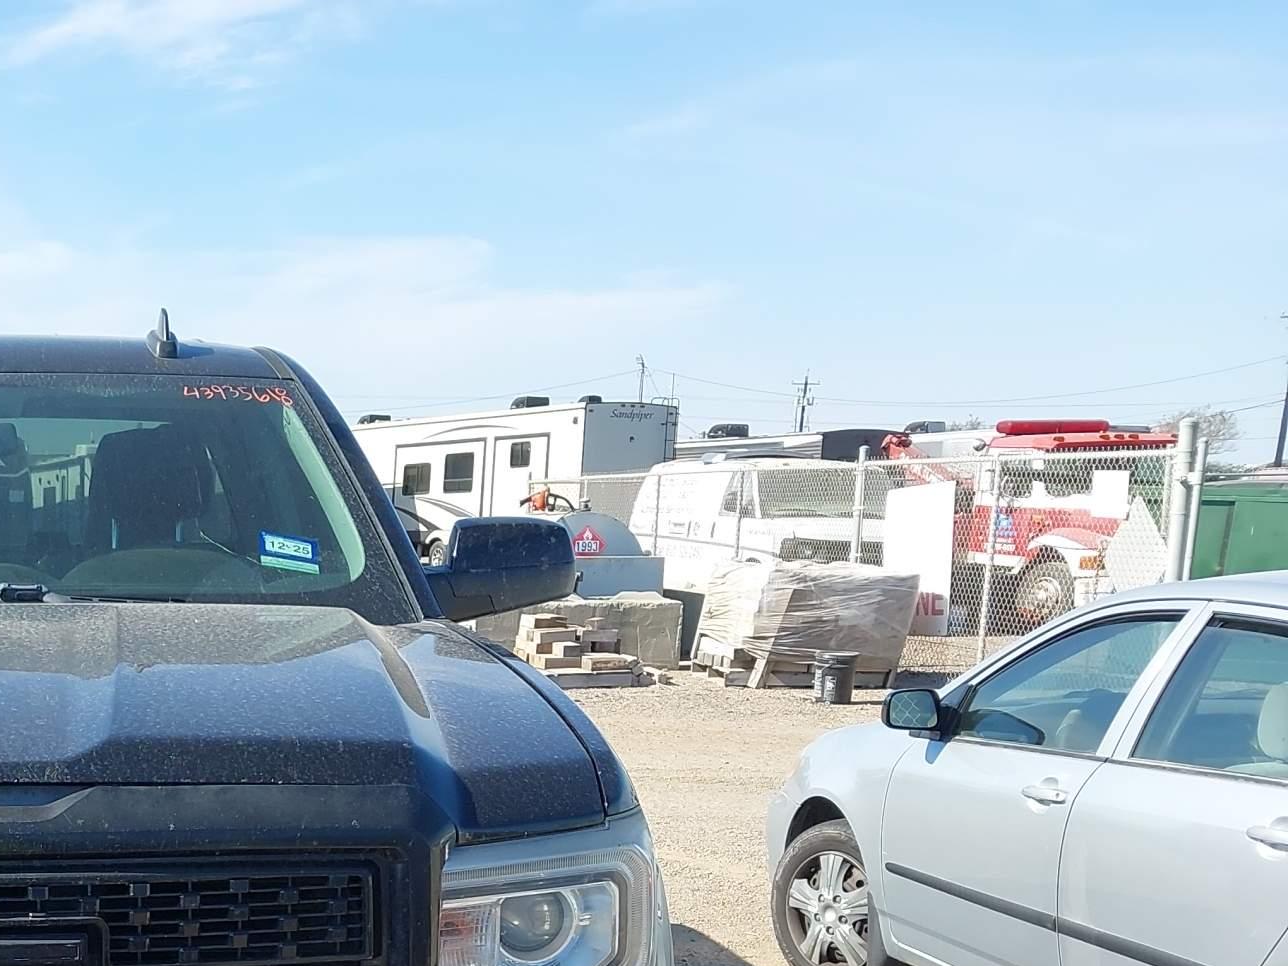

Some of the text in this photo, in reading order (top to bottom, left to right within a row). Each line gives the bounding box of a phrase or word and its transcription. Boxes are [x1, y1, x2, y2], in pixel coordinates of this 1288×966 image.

[183, 384, 293, 406] 43935618
[610, 408, 654, 422] Sandpiper
[576, 541, 598, 552] 1993
